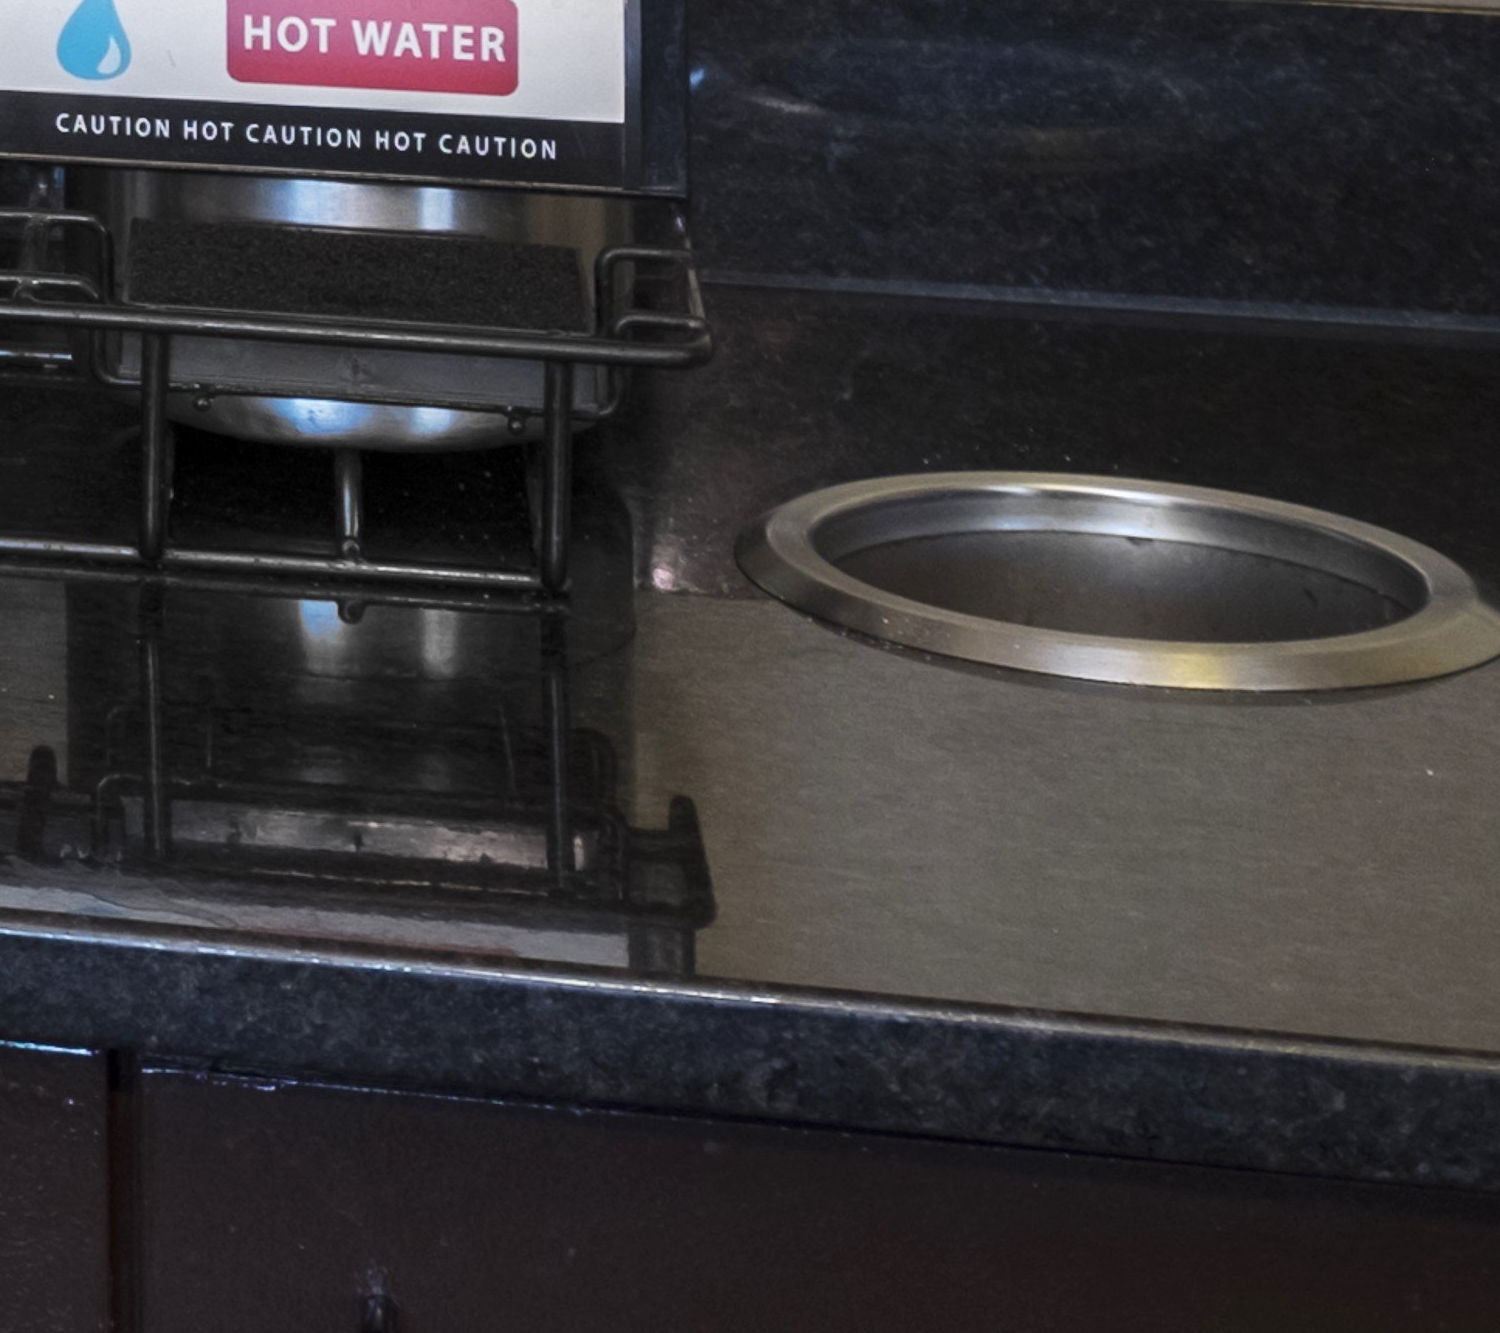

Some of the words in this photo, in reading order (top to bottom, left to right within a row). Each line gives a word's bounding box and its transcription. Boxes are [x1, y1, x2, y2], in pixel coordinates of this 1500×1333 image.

[243, 14, 337, 53] HOT
[351, 19, 506, 62] WATER
[55, 112, 170, 138] CAUTION
[183, 119, 234, 142] HOT
[245, 123, 361, 149] CAUTION
[375, 130, 427, 153] HOT
[438, 134, 557, 160] CAUTION
